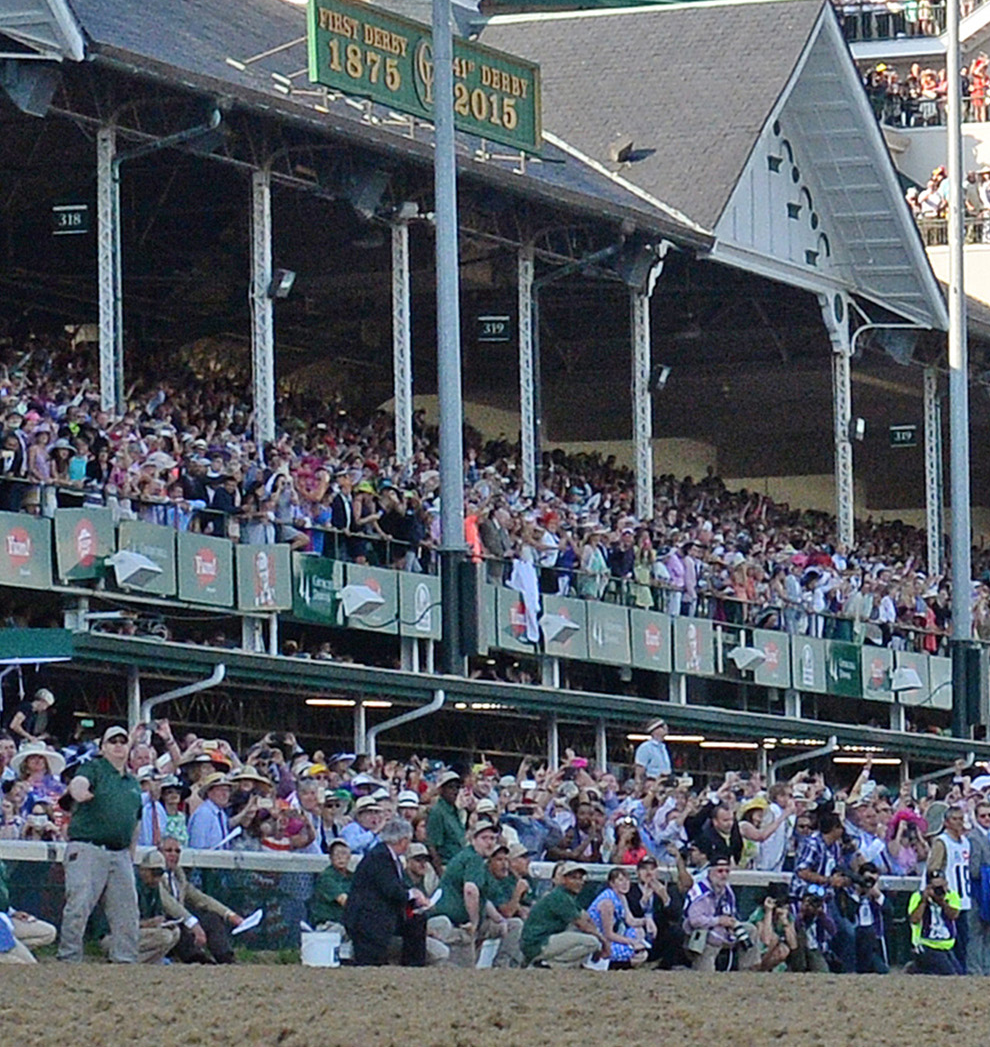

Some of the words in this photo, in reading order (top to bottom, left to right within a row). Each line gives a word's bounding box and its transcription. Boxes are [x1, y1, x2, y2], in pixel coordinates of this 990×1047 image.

[318, 7, 359, 40] FIRST
[364, 23, 408, 58] DERBY
[329, 38, 402, 91] 1875
[482, 65, 528, 99] DERBY
[454, 82, 518, 129] 2015
[59, 213, 81, 226] 318
[483, 322, 505, 334] 319
